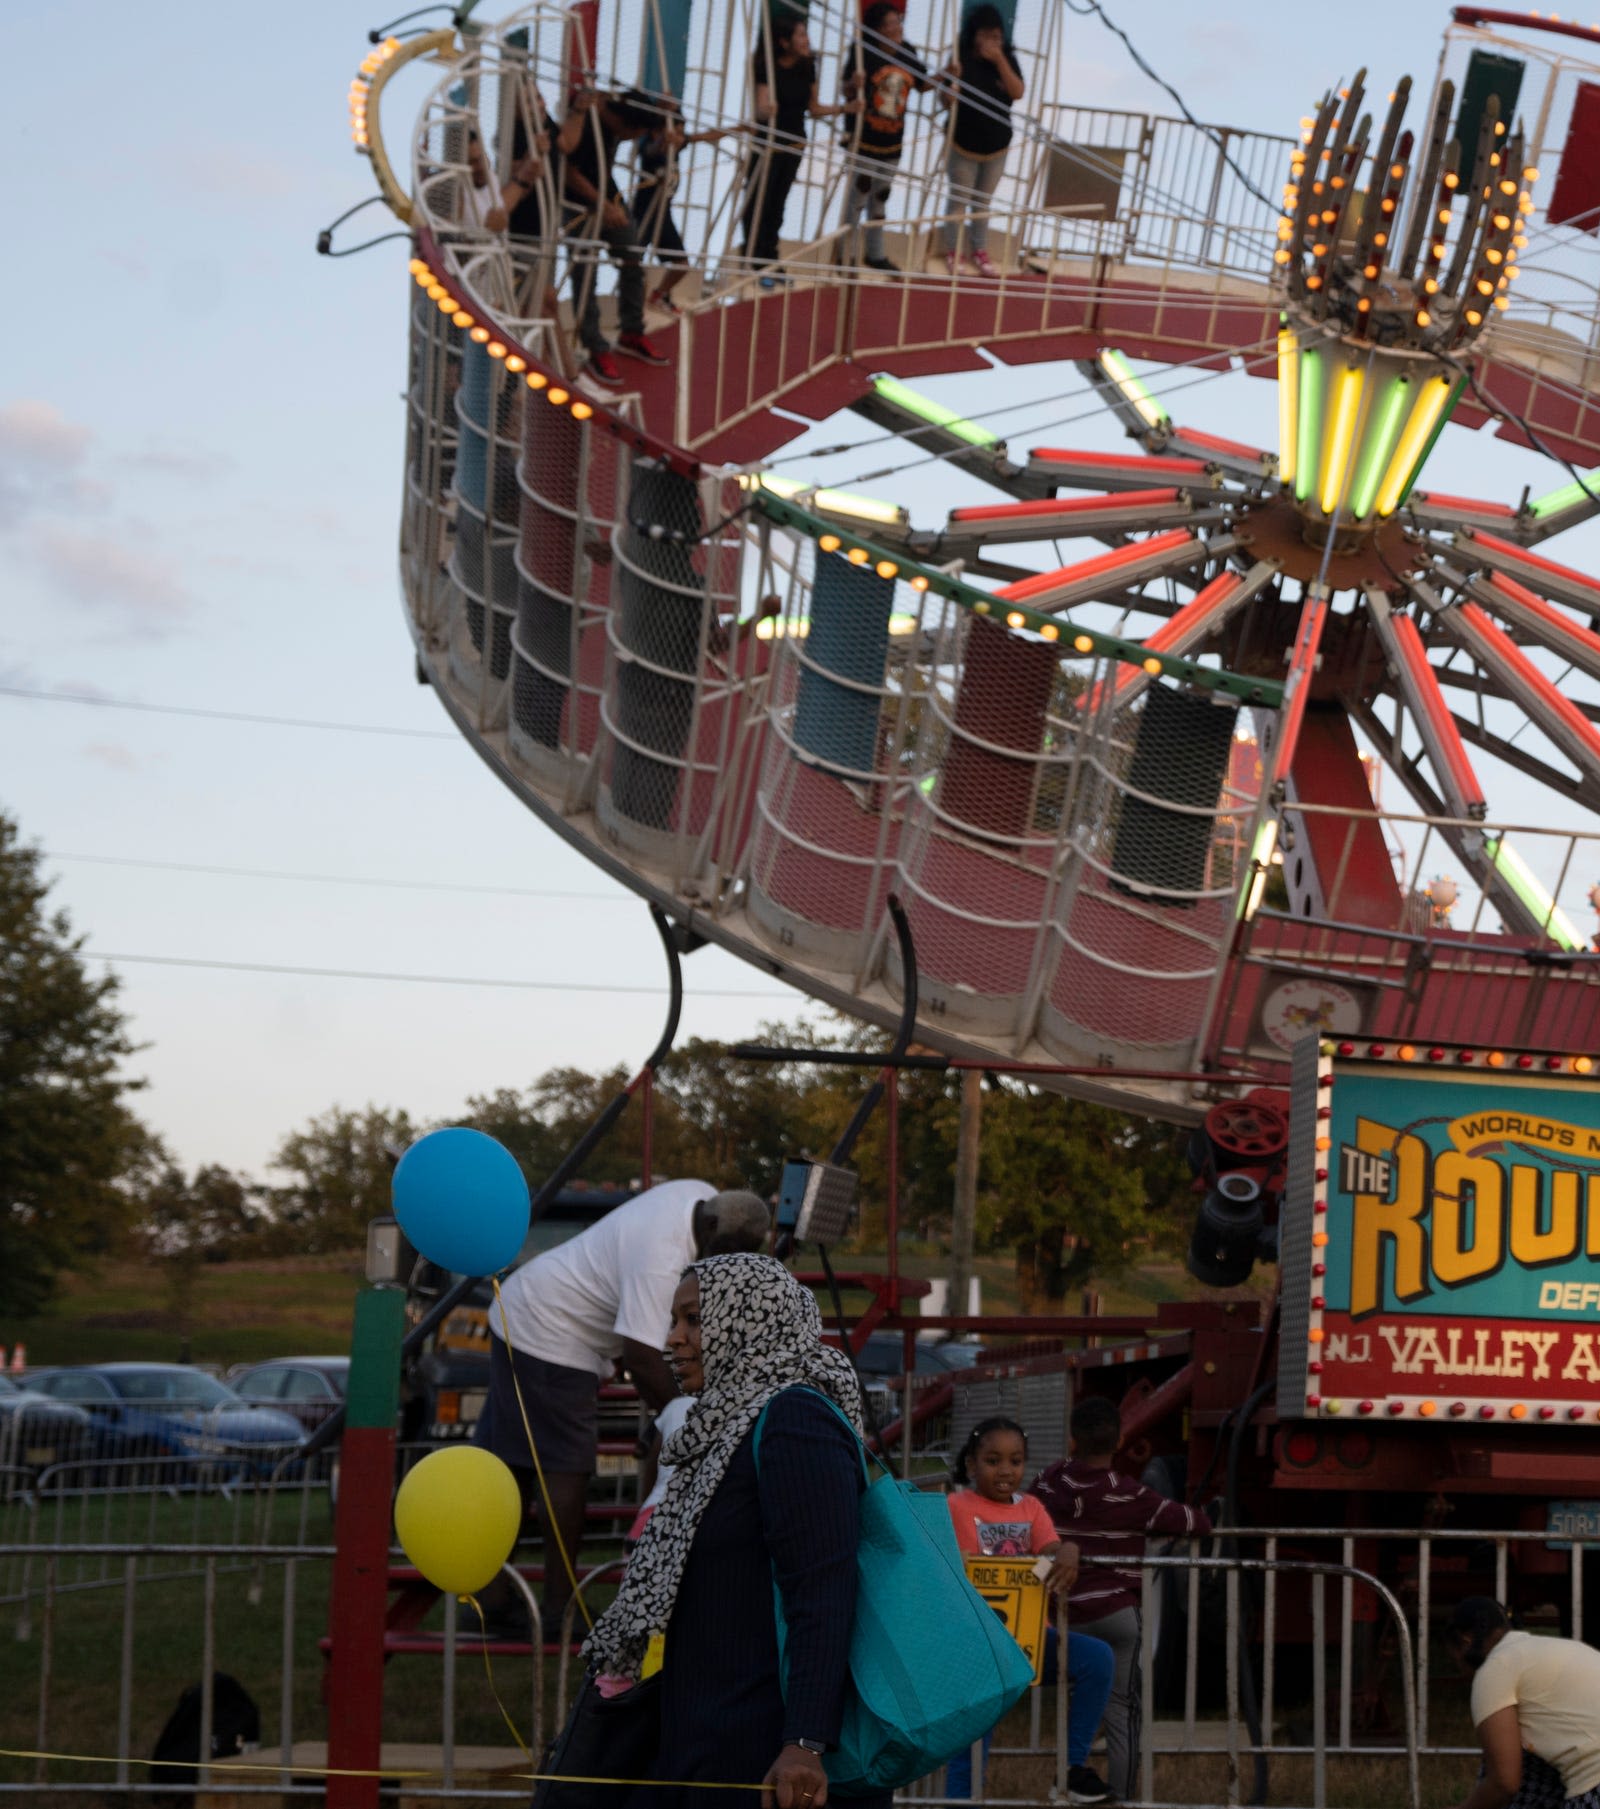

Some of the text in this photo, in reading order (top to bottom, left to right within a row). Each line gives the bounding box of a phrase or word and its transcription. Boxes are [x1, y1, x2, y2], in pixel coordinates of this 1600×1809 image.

[1461, 1116, 1576, 1147] WORLD'S
[1341, 1147, 1390, 1193] THE
[1378, 1326, 1560, 1382] VALLEY
[972, 1568, 998, 1584] RIDE
